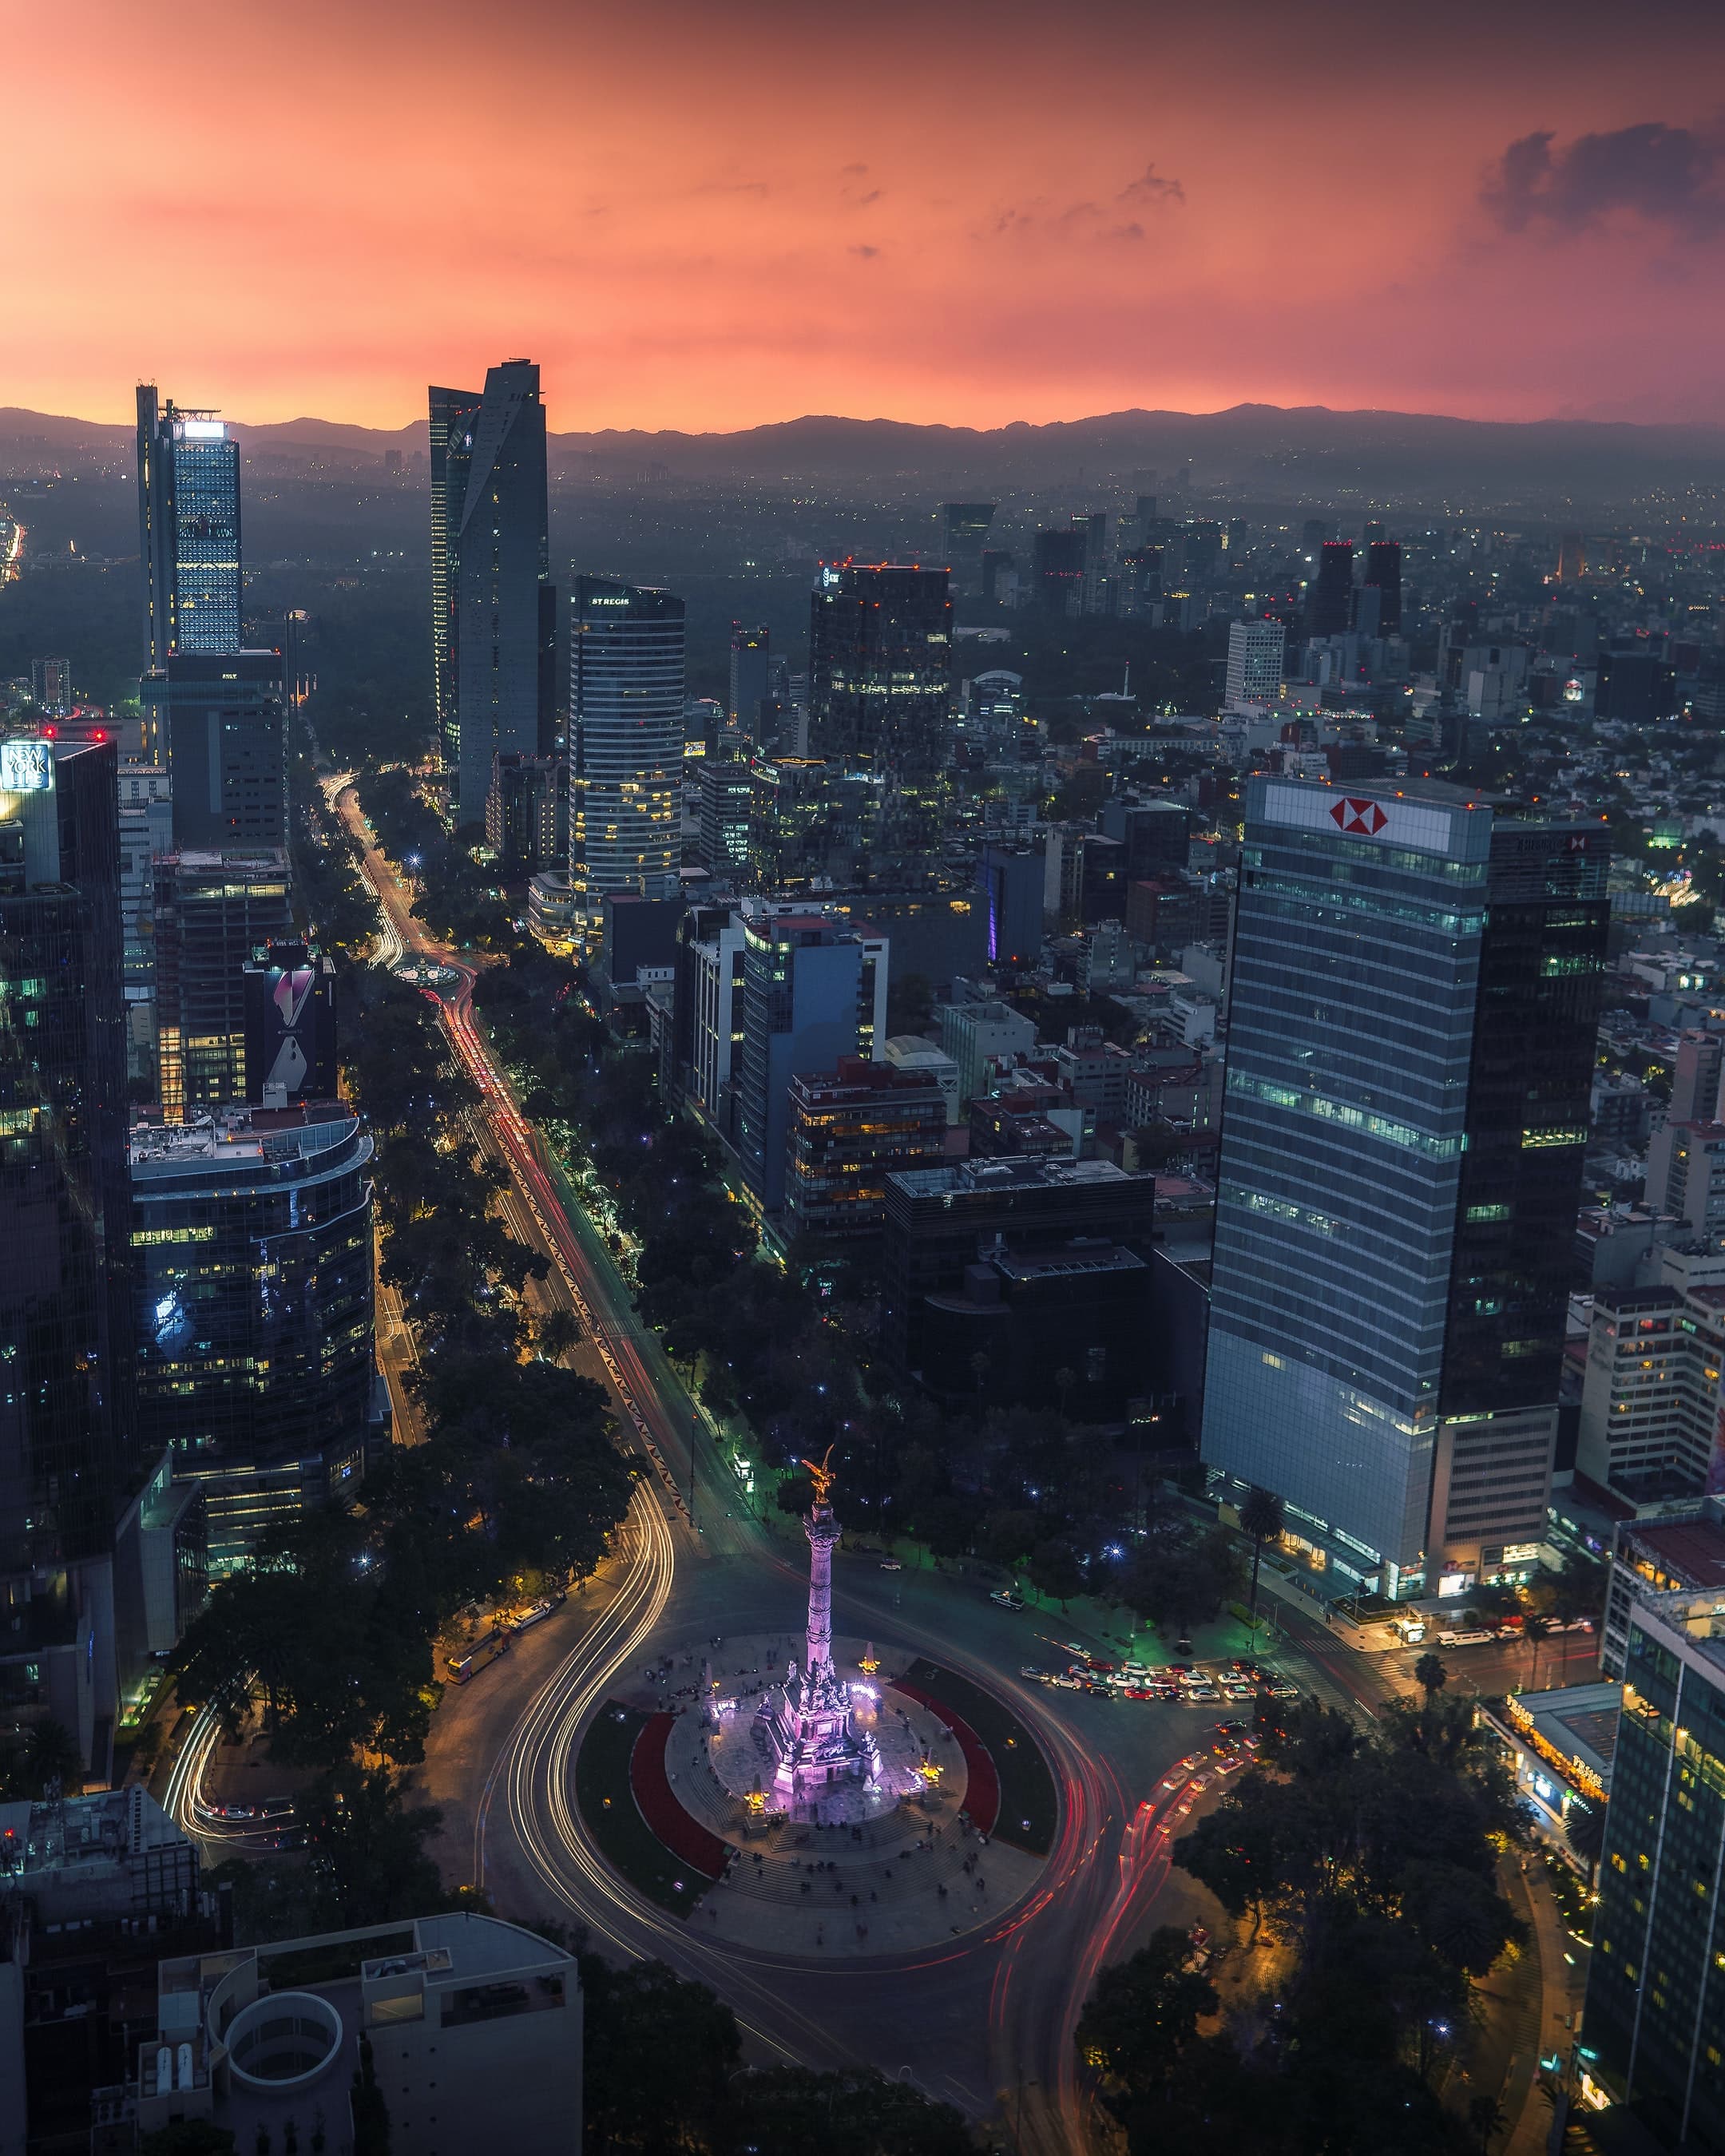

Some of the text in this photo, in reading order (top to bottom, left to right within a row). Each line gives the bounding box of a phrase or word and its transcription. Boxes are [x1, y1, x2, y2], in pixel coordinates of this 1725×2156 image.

[9, 748, 42, 761] NEW
[7, 759, 46, 774] YORK
[10, 771, 43, 785] LIFE
[1572, 1754, 1604, 1789] PRIME
